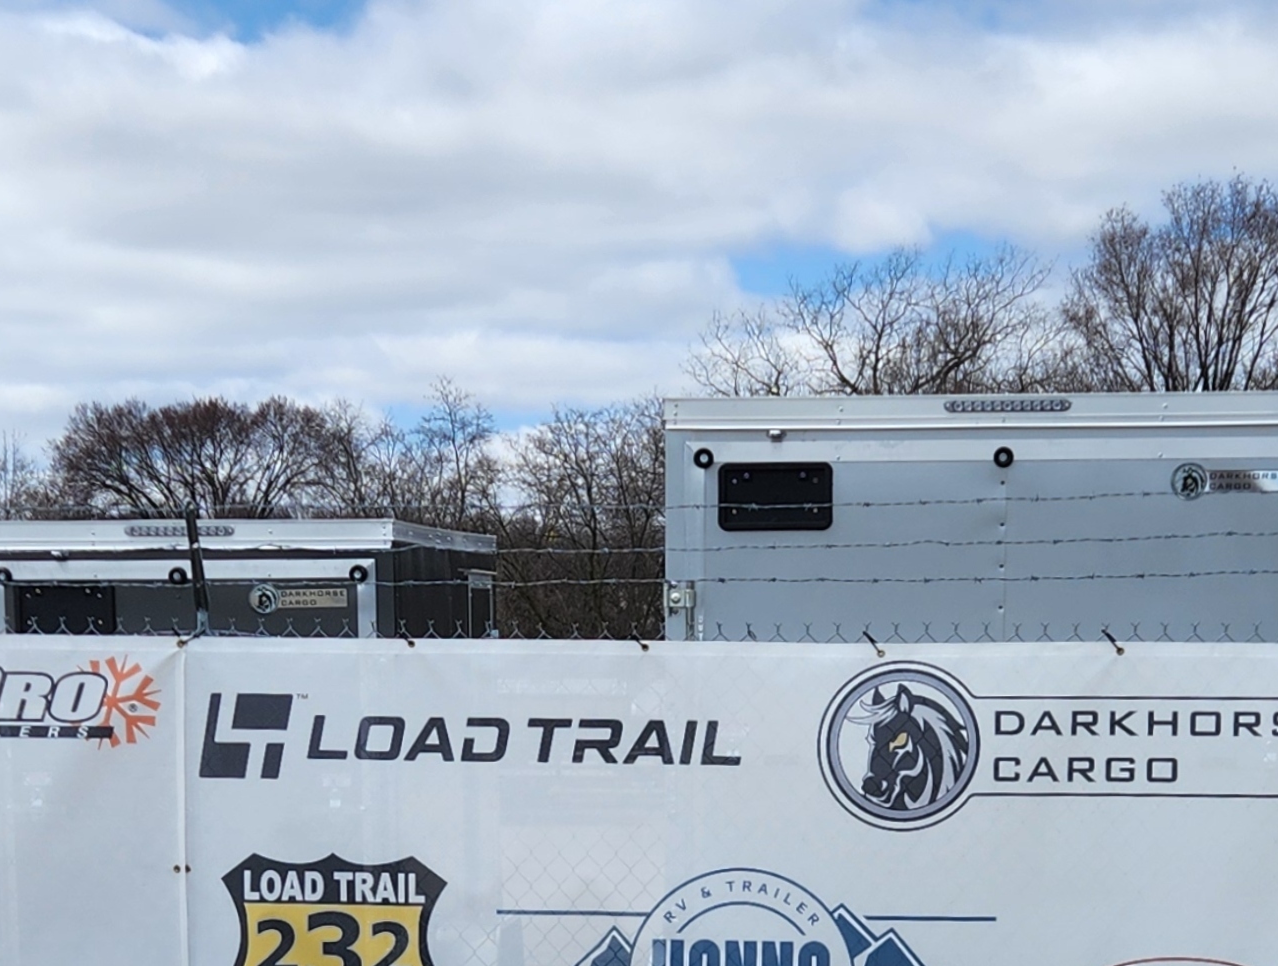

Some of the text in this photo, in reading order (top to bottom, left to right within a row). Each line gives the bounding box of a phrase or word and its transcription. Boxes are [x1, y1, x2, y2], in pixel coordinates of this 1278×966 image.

[1209, 482, 1252, 491] CARGO
[280, 589, 346, 598] DARKHORSE
[280, 598, 318, 607] CARGO
[307, 715, 742, 766] LOAD TRAIL
[992, 757, 1180, 784] CARGO
[243, 870, 426, 904] LOAD TRAIL
[663, 880, 820, 926] RV & TRAILER
